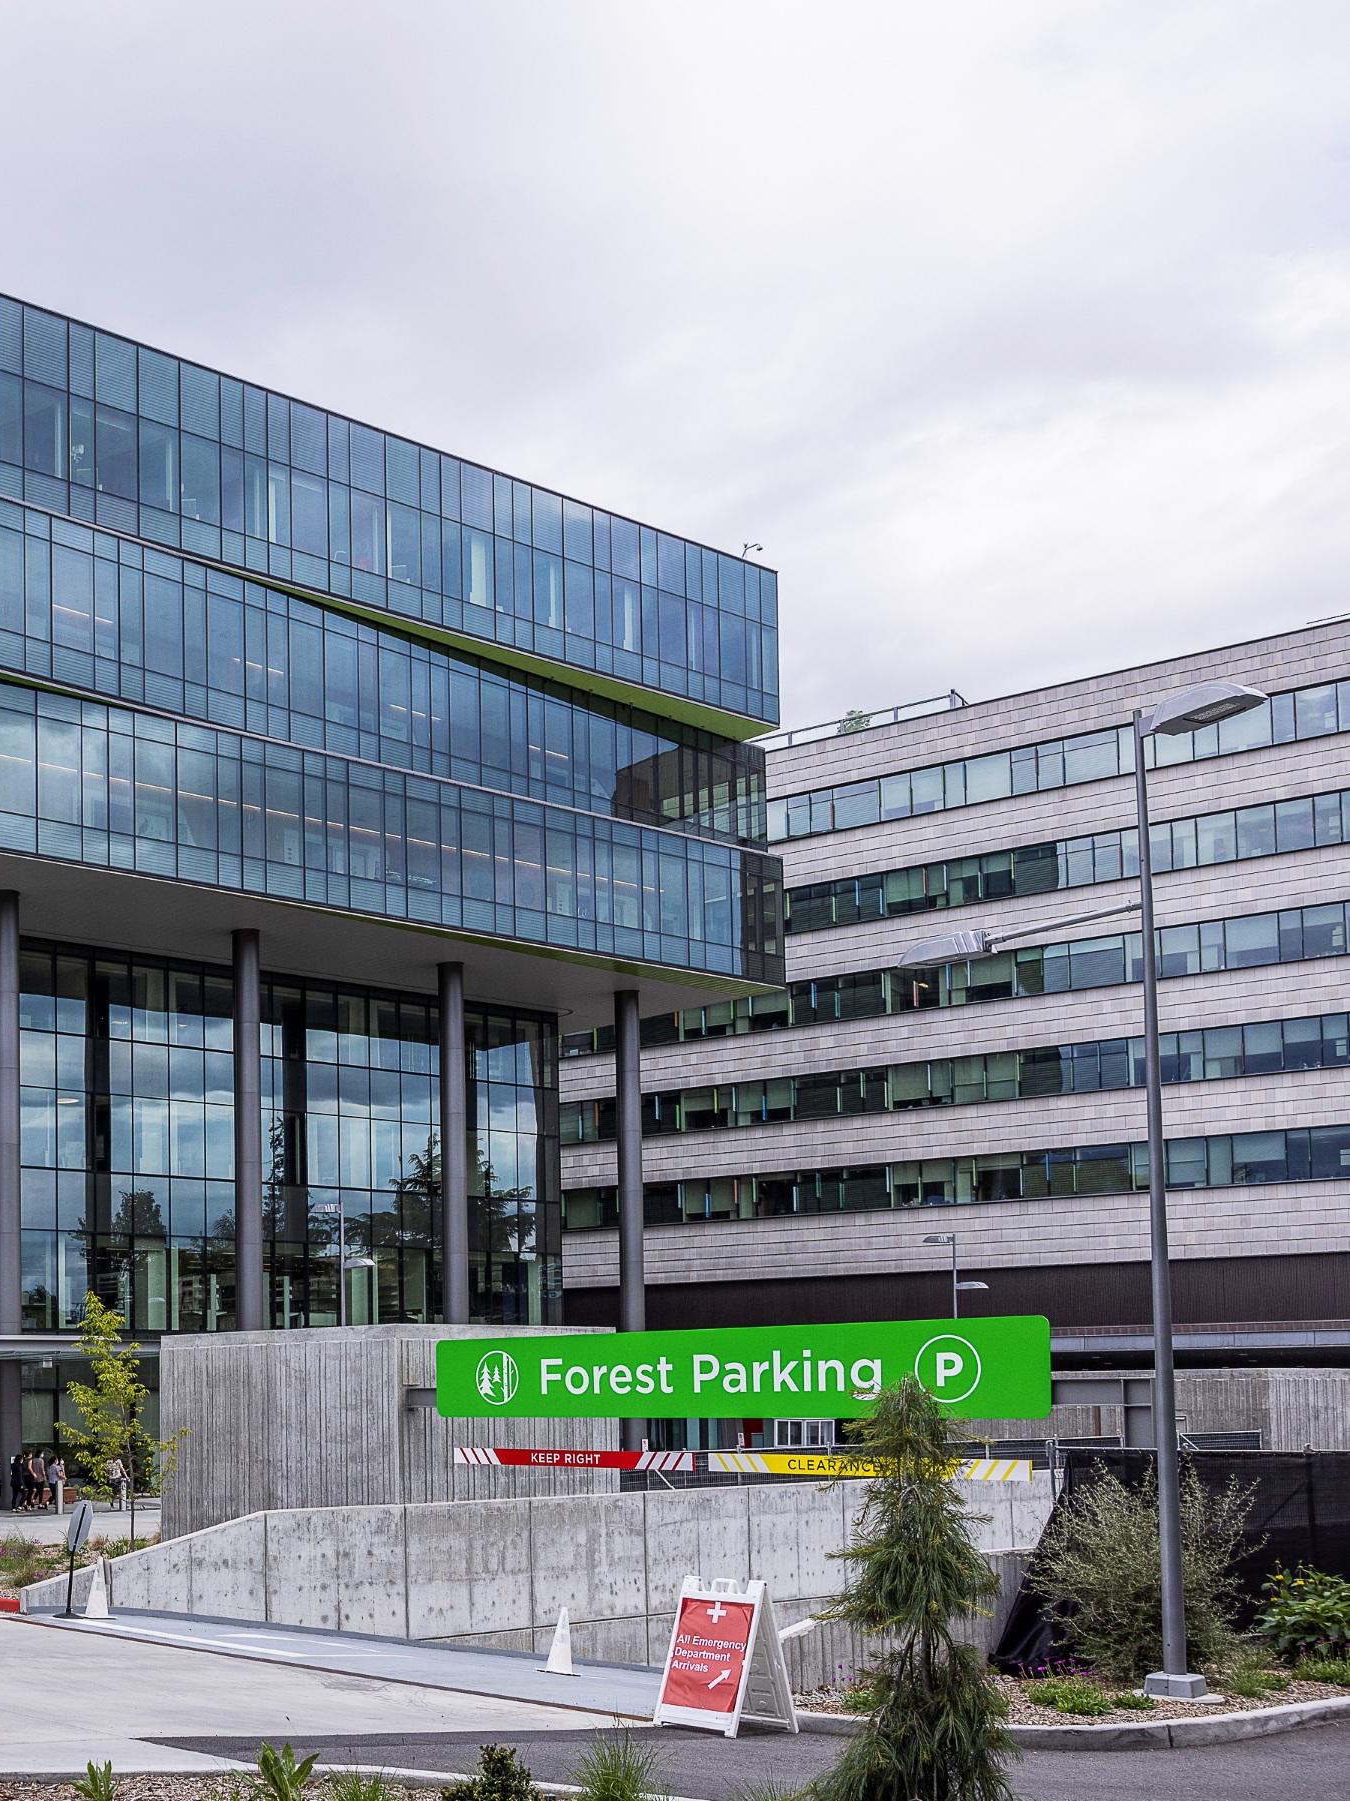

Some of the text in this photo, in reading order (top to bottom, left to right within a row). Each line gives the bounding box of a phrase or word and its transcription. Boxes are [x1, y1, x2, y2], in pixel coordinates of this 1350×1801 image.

[540, 1350, 964, 1401] Forest Parking P
[531, 1453, 601, 1465] KEEP RIGHT
[676, 1634, 747, 1652] All Emergency
[675, 1647, 730, 1662] Department
[671, 1660, 709, 1673] Arrivals
